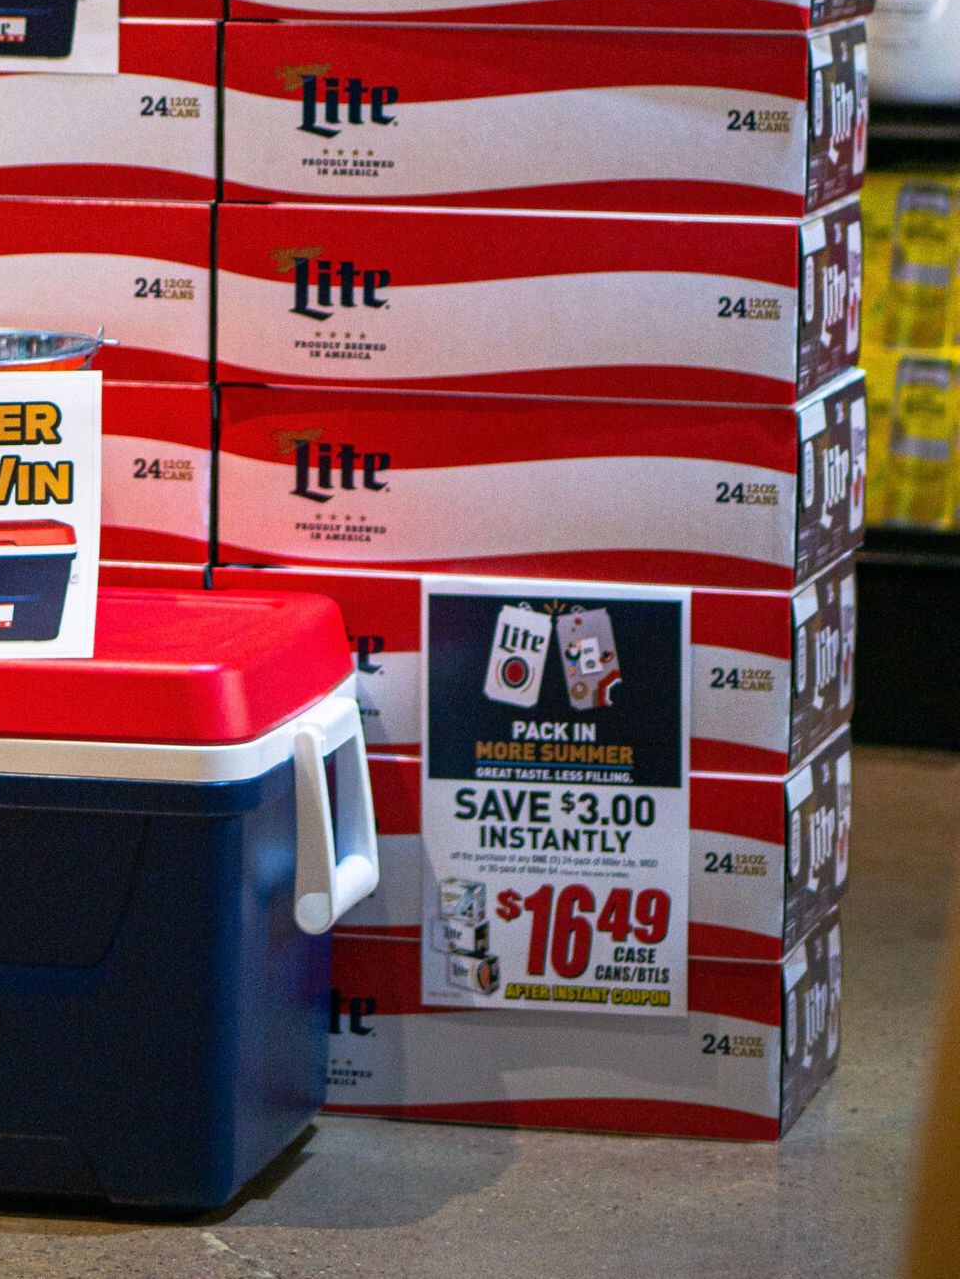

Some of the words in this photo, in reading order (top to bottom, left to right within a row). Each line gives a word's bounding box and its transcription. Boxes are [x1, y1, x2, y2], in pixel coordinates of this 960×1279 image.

[140, 96, 168, 117] 24
[167, 107, 198, 118] CANS
[297, 72, 396, 140] Lite
[727, 109, 757, 131] 24
[756, 121, 789, 132] CANS
[134, 277, 163, 299] 24
[162, 288, 194, 300] CANS
[289, 254, 388, 323] Lite
[718, 296, 748, 318] 24
[747, 308, 780, 320] CANS
[133, 458, 162, 480] 24
[290, 438, 388, 504] Lite
[715, 481, 745, 504] 24
[744, 493, 777, 506] CANS
[498, 621, 546, 655] Lite
[710, 667, 740, 690] 24
[739, 679, 772, 692] CANS
[512, 719, 568, 740] PACK
[573, 722, 597, 742] IN
[474, 740, 537, 761] MORE
[539, 743, 635, 764] SUMMER
[475, 766, 513, 779] GREAT
[514, 767, 553, 781] TASTE.
[554, 769, 584, 782] LESS
[585, 770, 634, 783] FILLING.
[454, 787, 552, 823] SAVE
[560, 790, 656, 827] $3.00
[479, 825, 632, 854] INSTANTLY
[704, 852, 734, 874] 24
[613, 946, 657, 964] CASE
[594, 964, 671, 984] CANS/BTLS
[505, 982, 550, 1000] AFTER
[552, 985, 609, 1004] INSTANT
[610, 989, 671, 1007] COUPON
[702, 1033, 731, 1055] 24
